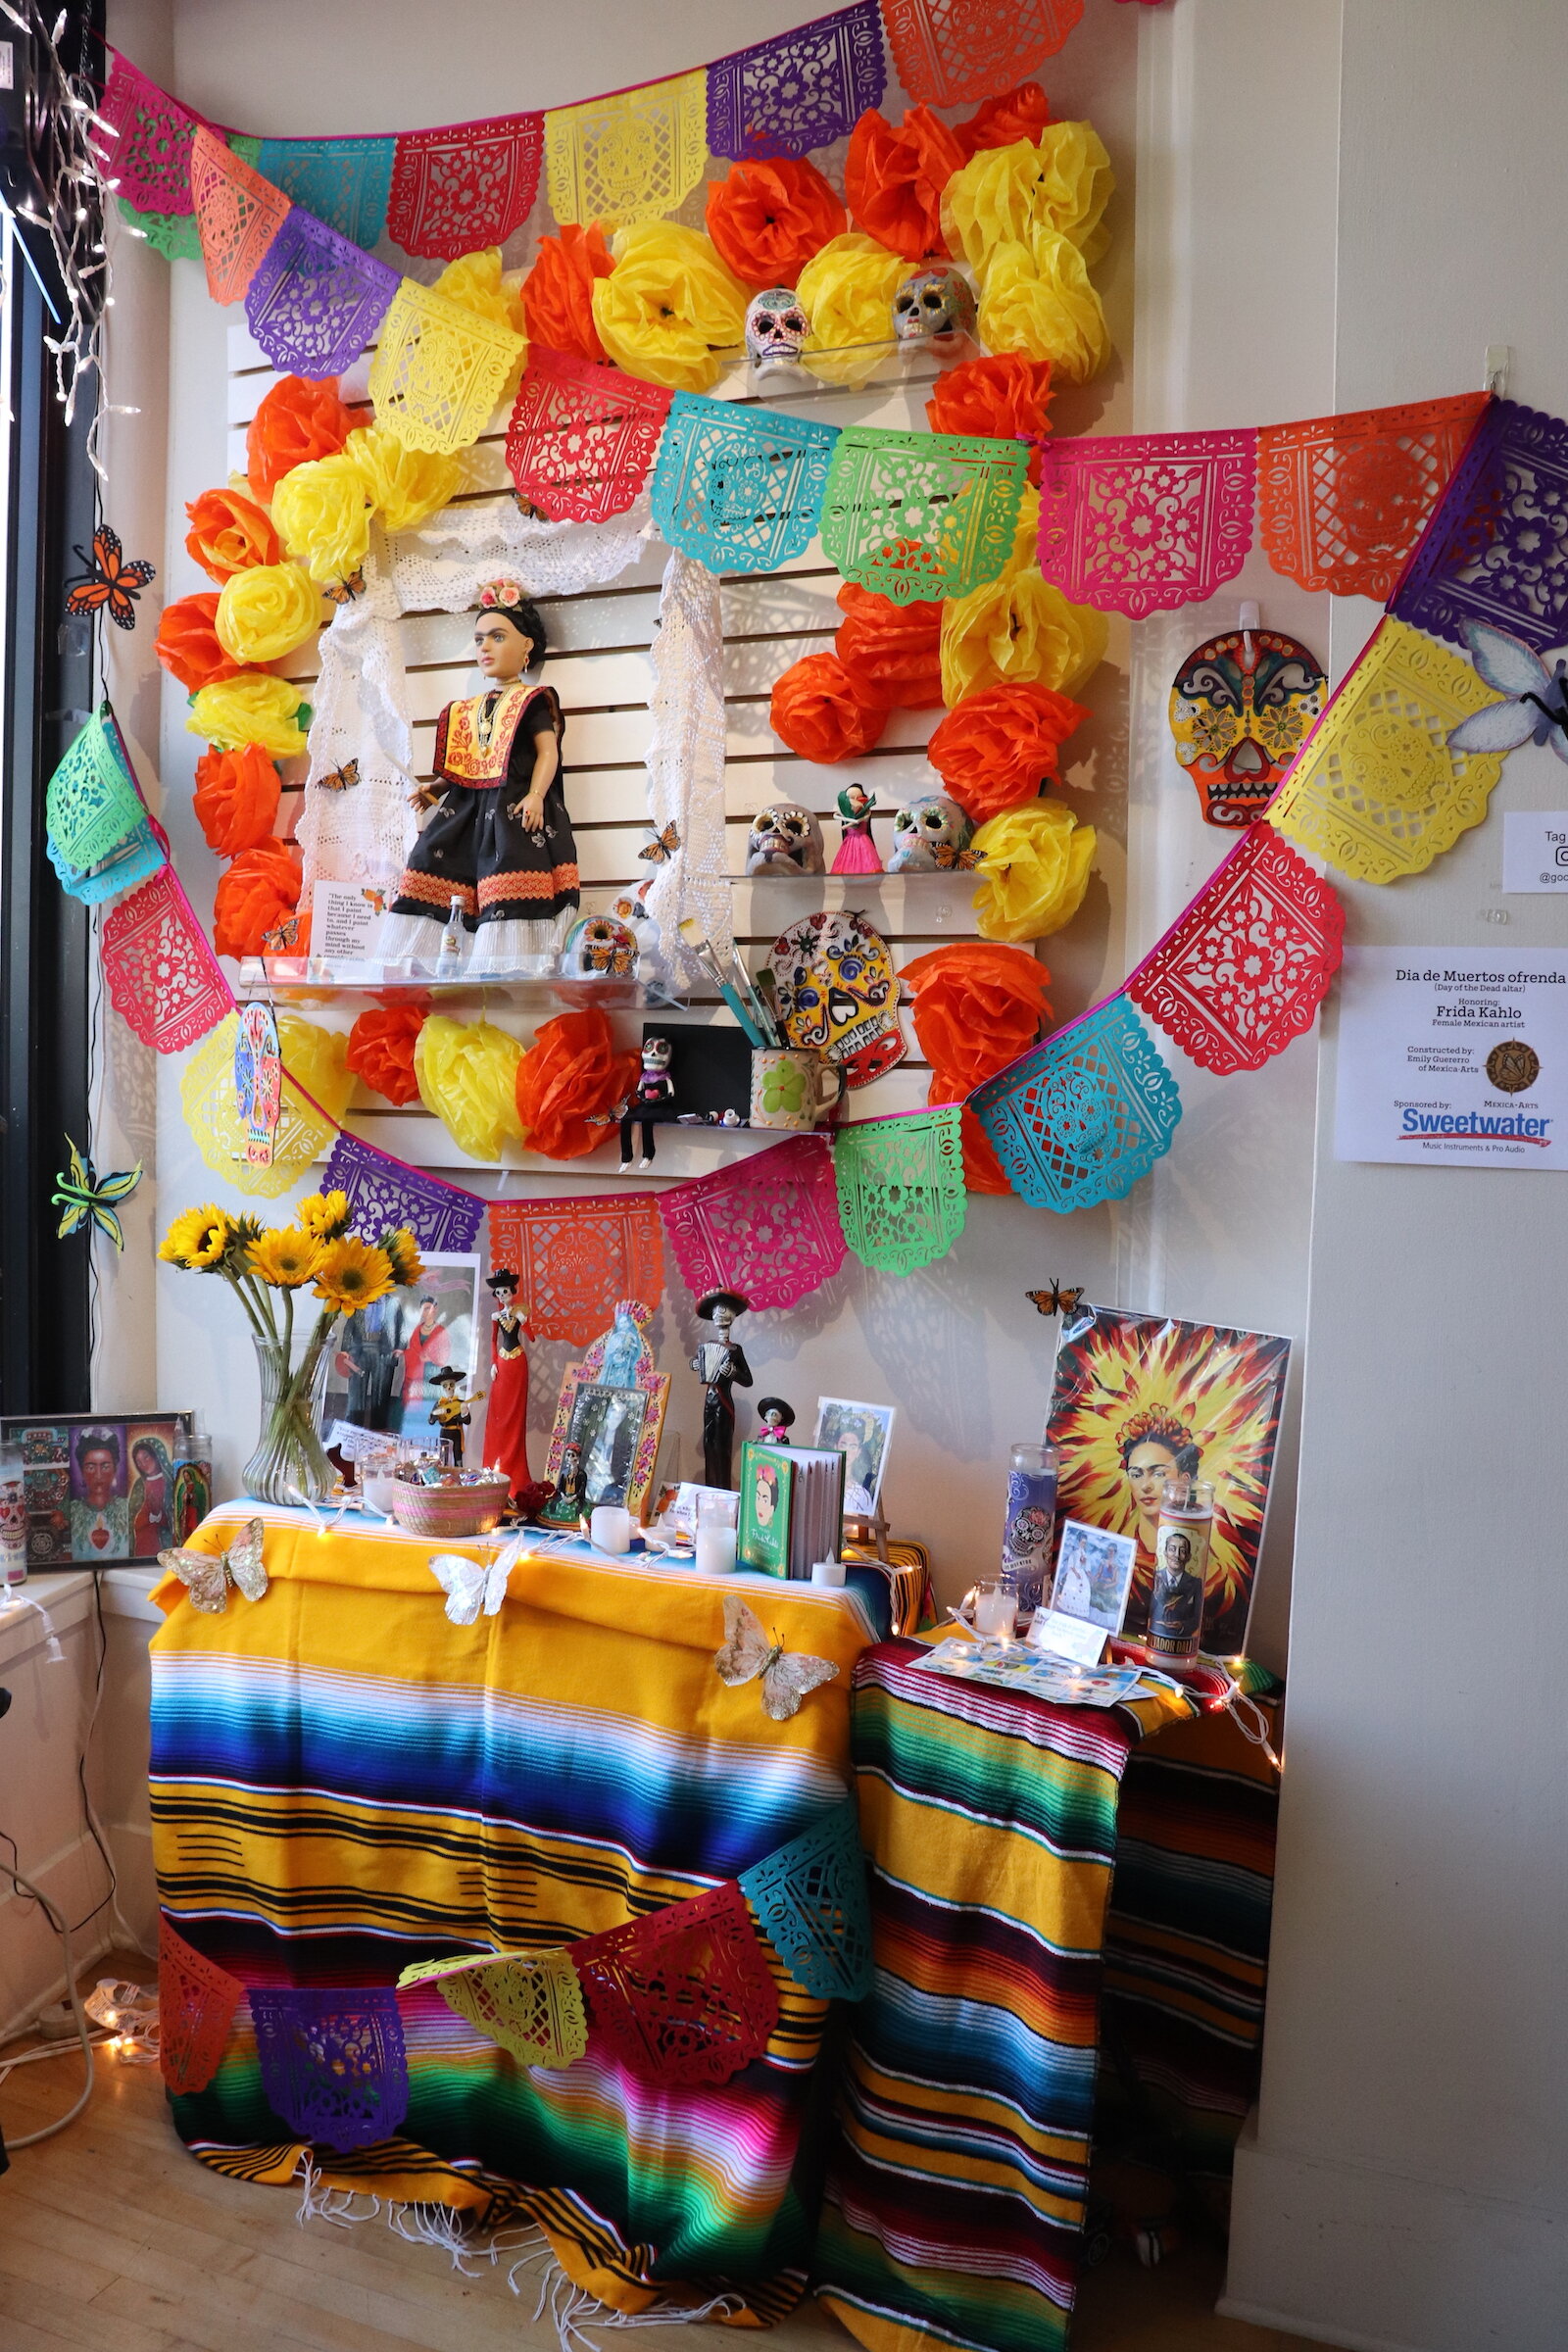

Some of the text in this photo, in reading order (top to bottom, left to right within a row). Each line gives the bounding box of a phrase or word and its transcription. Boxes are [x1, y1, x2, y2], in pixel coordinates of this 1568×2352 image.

[1544, 831, 1566, 844] Tag
[1396, 969, 1566, 984] Dia de Muertos ofrenda
[1434, 983, 1453, 992] (Day
[1458, 998, 1500, 1006] Honoring:
[1437, 1005, 1522, 1019] Frida Kahlo
[1407, 1046, 1475, 1055] Constructed by:
[1407, 1054, 1470, 1064] Emily Guererro
[1394, 1100, 1452, 1110] Sponsored by:
[1484, 1101, 1539, 1109] MEXICA-ARTS
[1402, 1108, 1550, 1137] Sweetwater
[1444, 1143, 1484, 1152] Instruments
[1504, 1145, 1526, 1153] Audio
